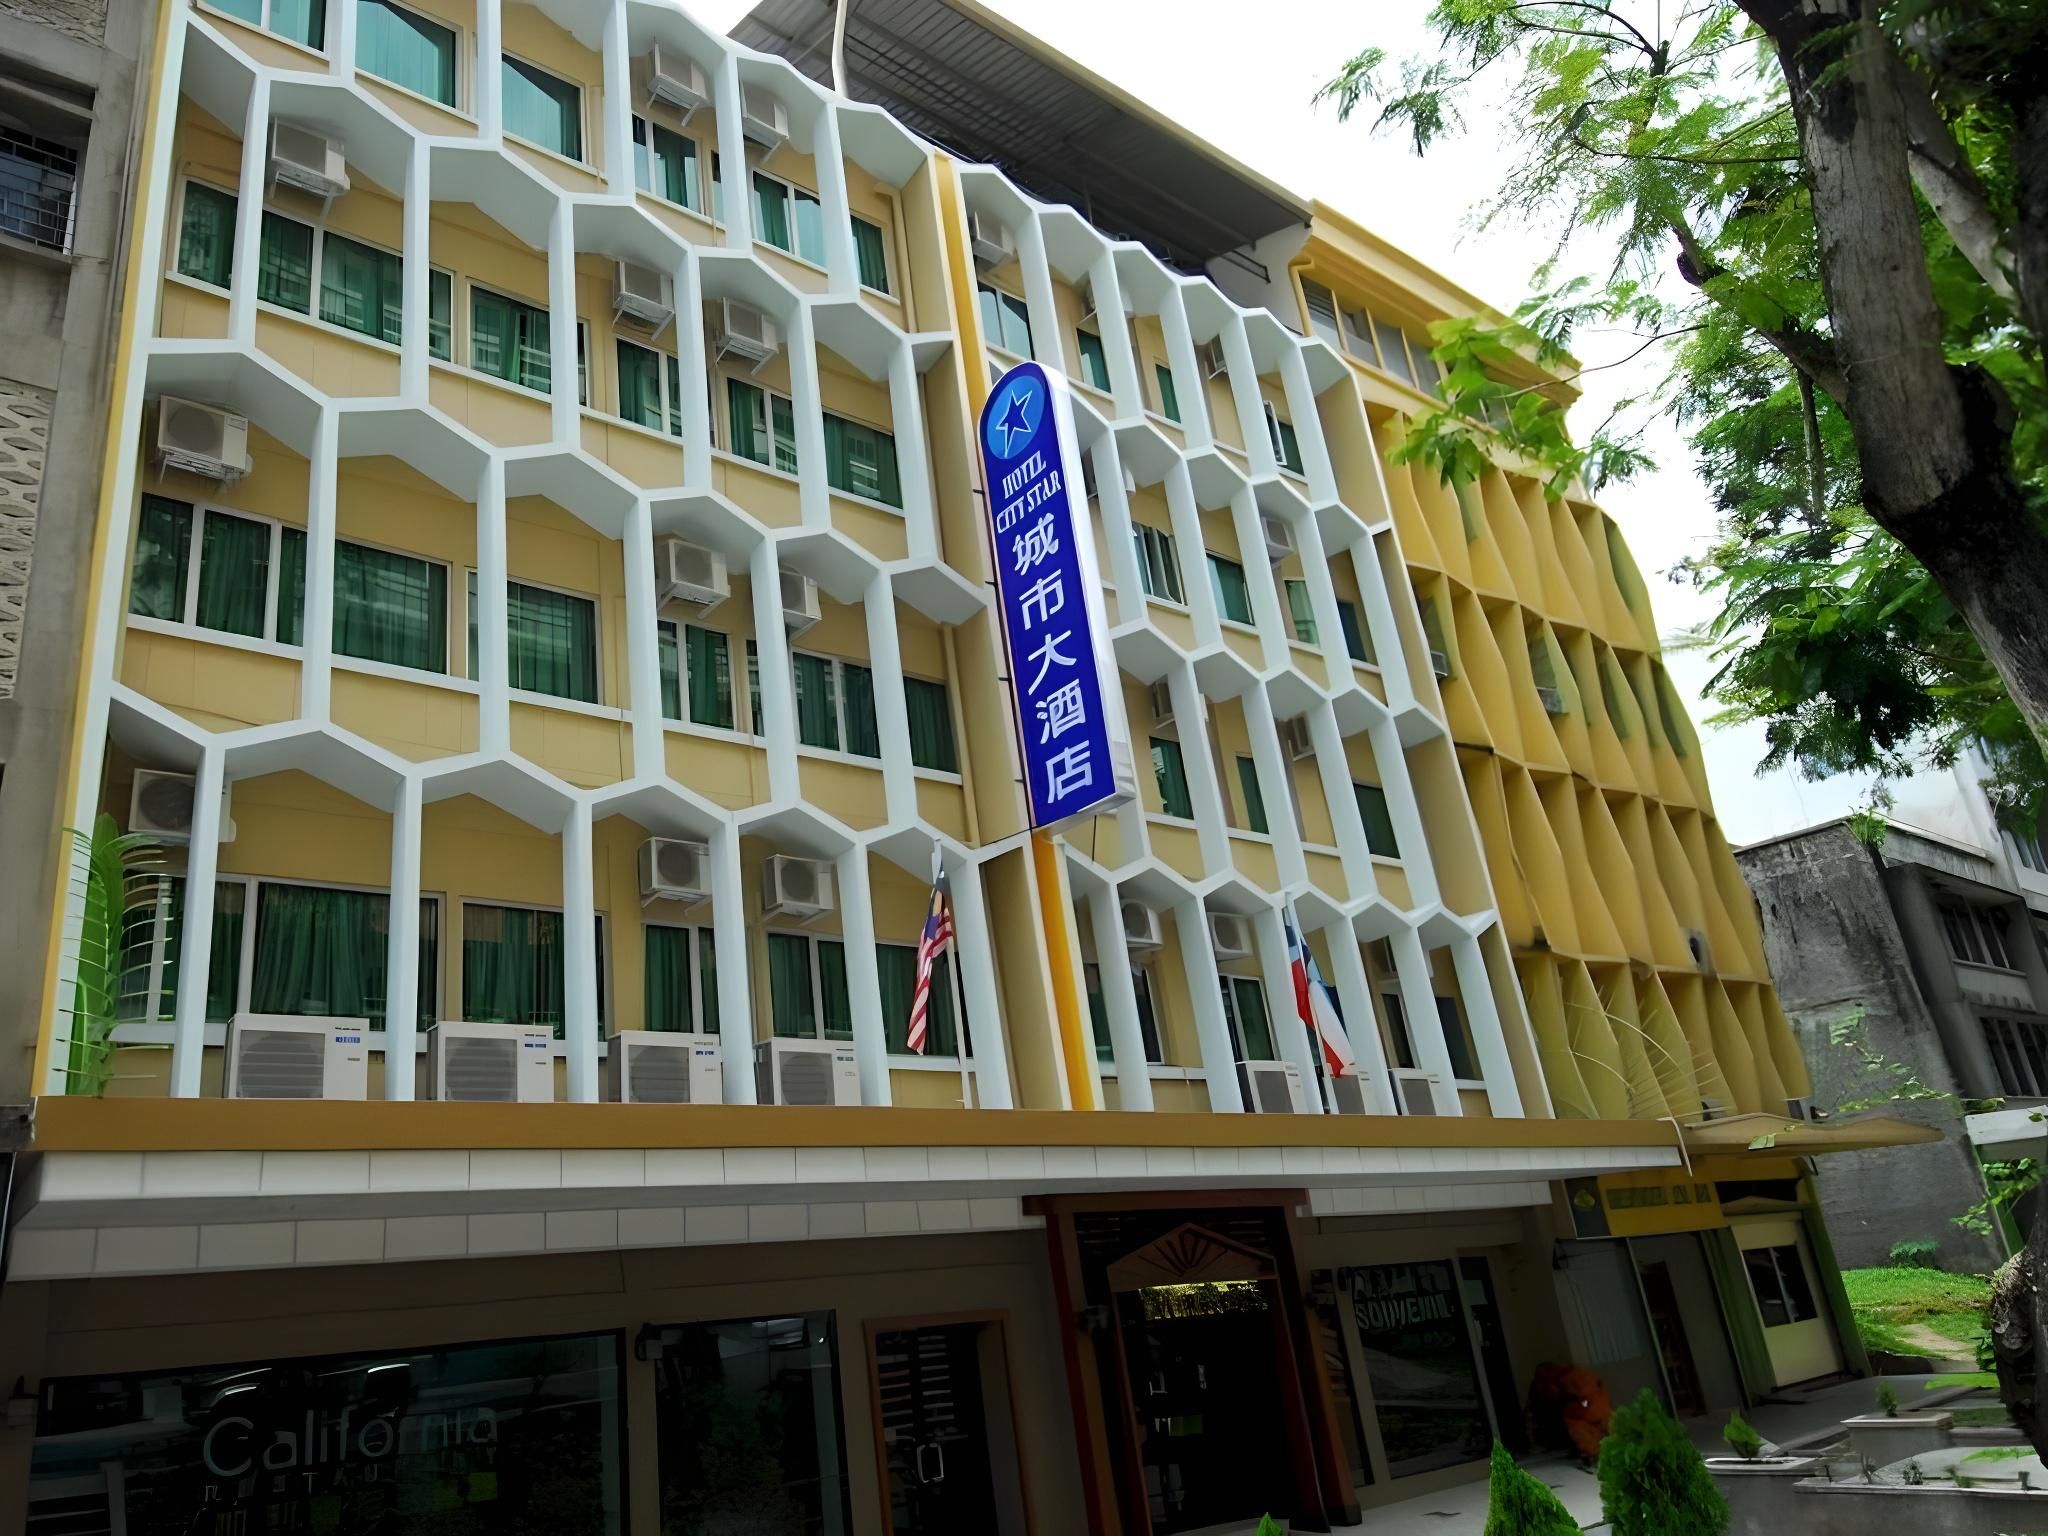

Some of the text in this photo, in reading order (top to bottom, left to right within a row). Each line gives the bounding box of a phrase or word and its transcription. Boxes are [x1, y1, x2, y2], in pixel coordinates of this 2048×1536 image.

[996, 470, 1062, 535] CITY STAR
[1012, 512, 1093, 804] 城市大酒店
[202, 1406, 499, 1478] Califonia
